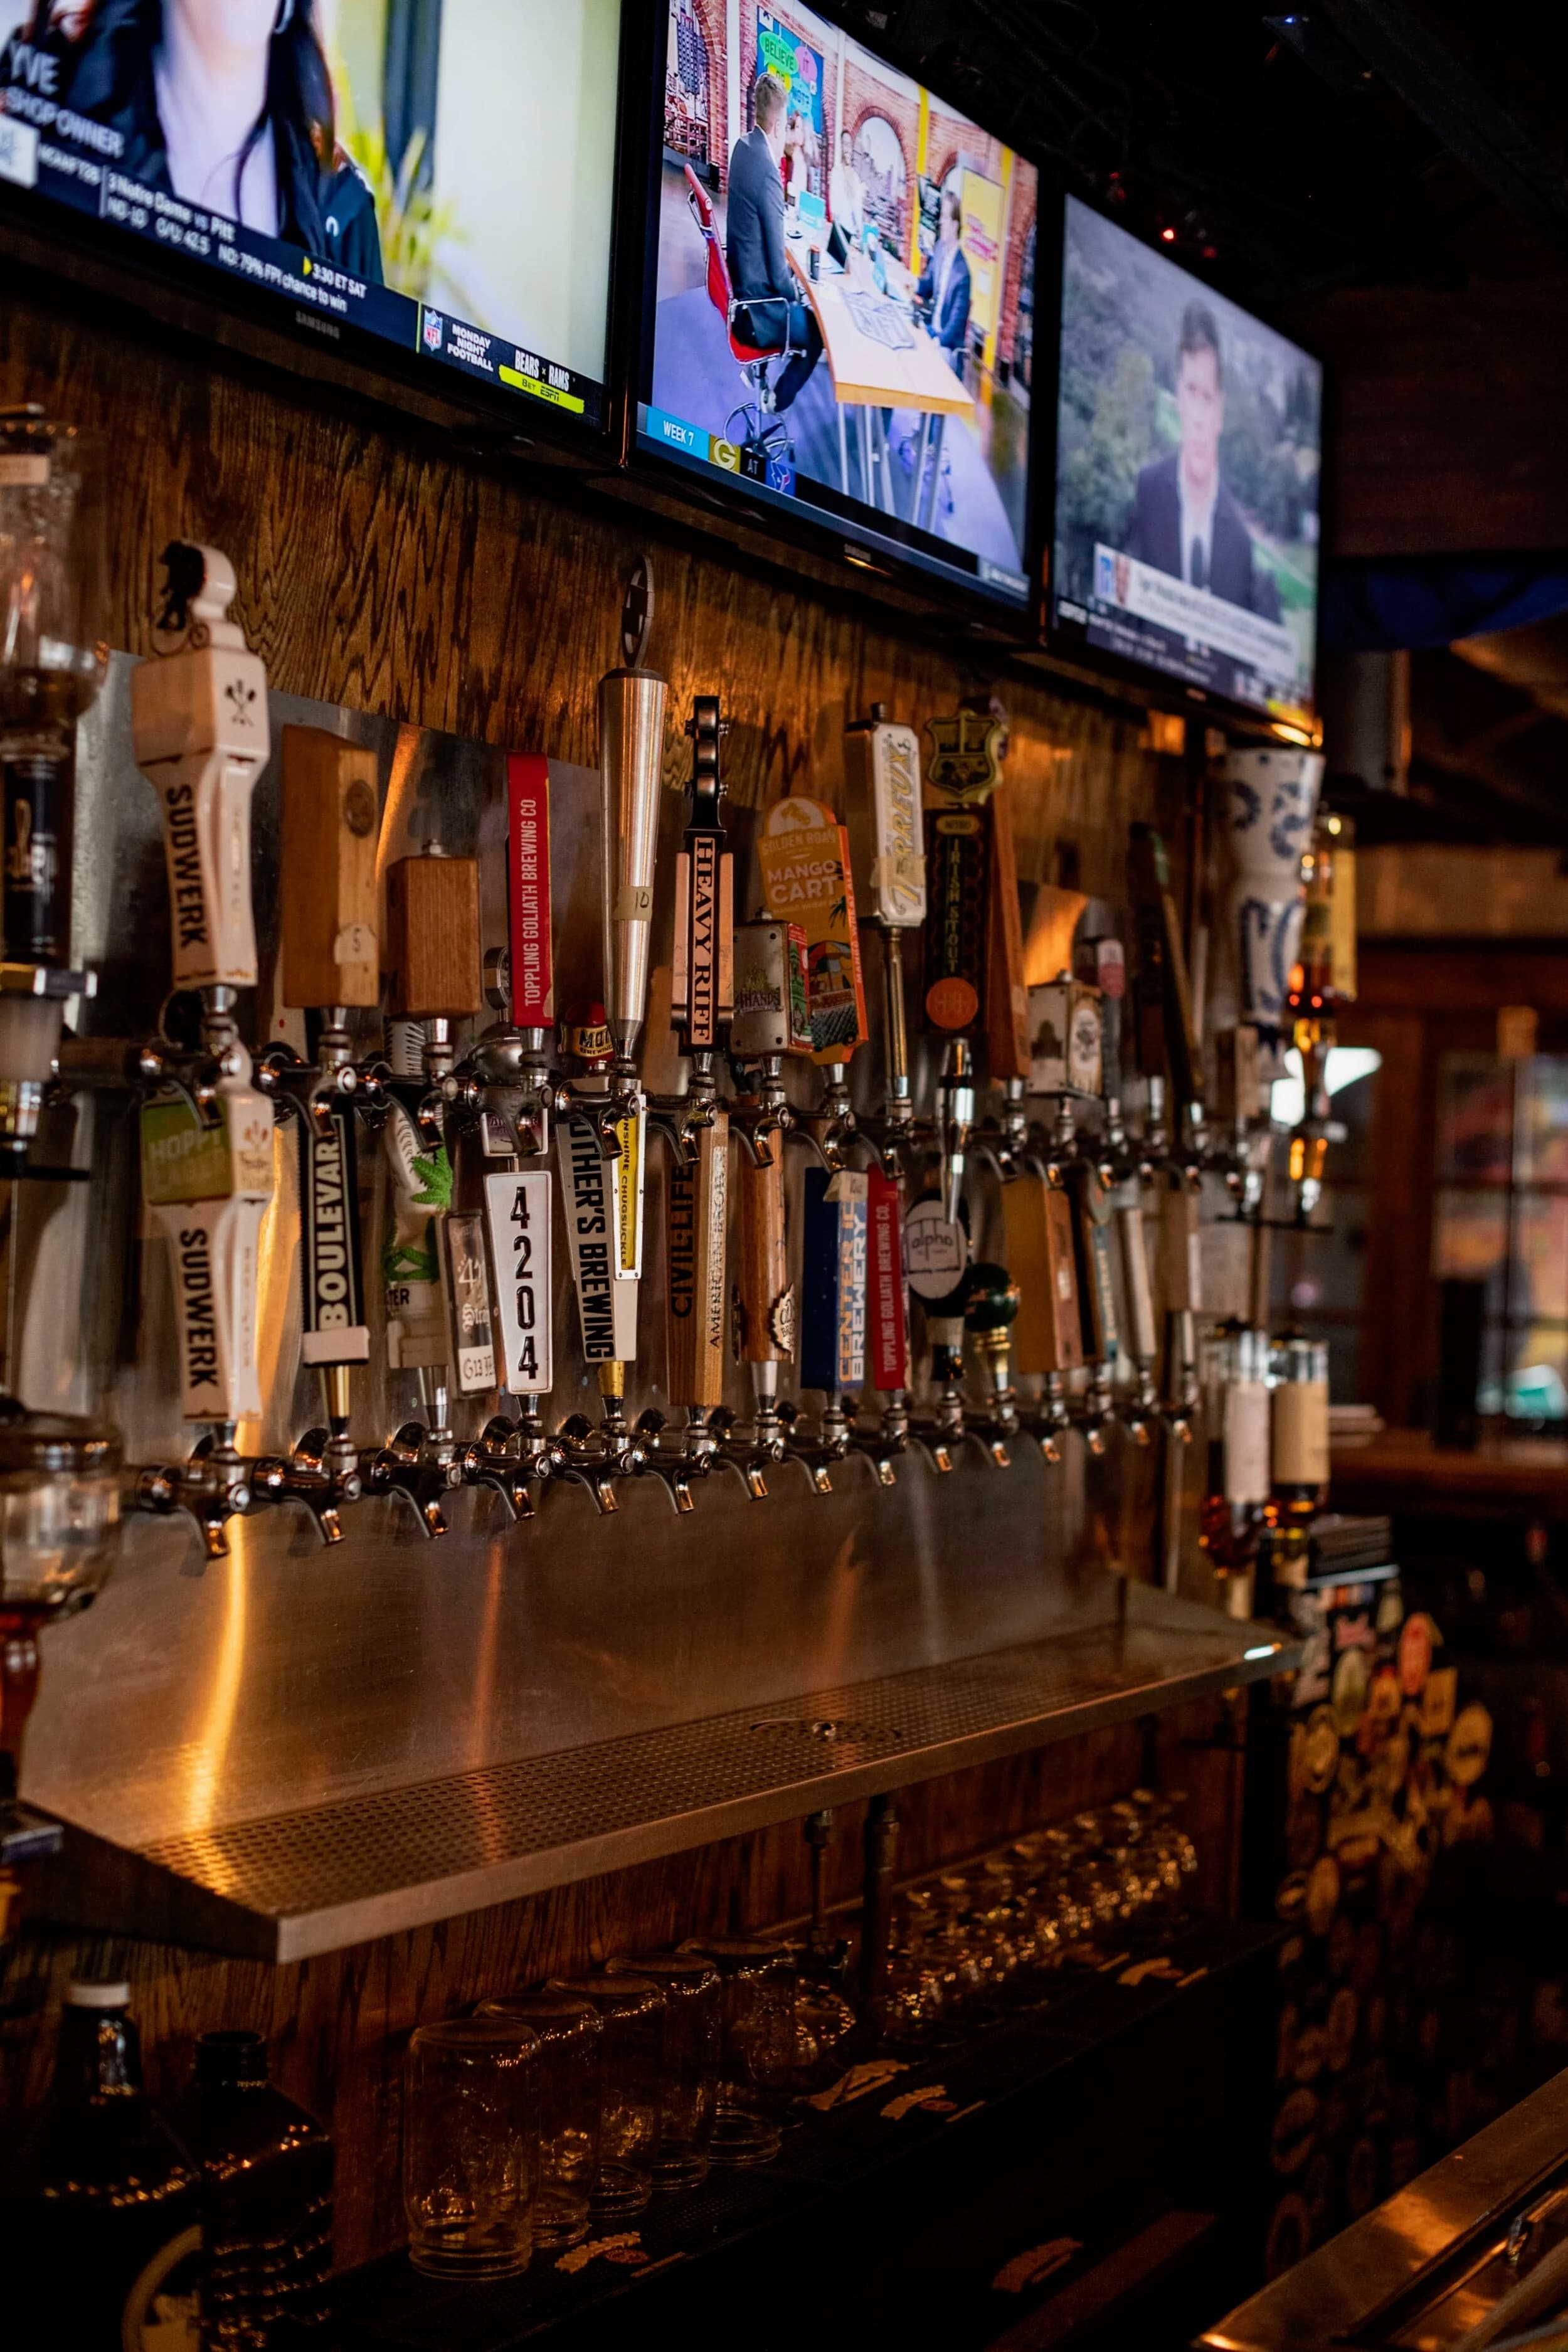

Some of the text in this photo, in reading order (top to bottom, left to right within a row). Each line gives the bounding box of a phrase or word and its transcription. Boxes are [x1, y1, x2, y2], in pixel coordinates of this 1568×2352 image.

[765, 37, 794, 71] BELIEVE
[802, 58, 810, 73] IT
[6, 86, 59, 126] SHOP
[55, 109, 124, 159] OWNER
[108, 172, 236, 243] 3 Notre Dame vs Pitt
[282, 273, 318, 302] chance
[317, 287, 329, 306] to
[329, 294, 349, 313] win
[312, 263, 368, 299] 3:30 ET SAT
[295, 310, 341, 339] SAMSUNG
[426, 327, 440, 345] NFL
[452, 323, 491, 349] MONDAY
[457, 337, 486, 357] NIGHT
[447, 343, 494, 373] FOOTBALL
[514, 349, 539, 379] BEARS
[548, 364, 569, 392] RAMS
[540, 386, 559, 402] ESPN
[663, 420, 694, 447] WEEK 7
[714, 438, 758, 475] G AT
[166, 784, 207, 948] SUDWERK
[521, 820, 538, 880] BREWING
[767, 859, 837, 884] MANGO
[522, 885, 539, 939] GOLIATH
[770, 876, 838, 903] CART
[948, 839, 961, 973] IRISH STOUT
[847, 894, 858, 936] WHEAT
[692, 838, 715, 1043] HEAVY RIFF
[852, 940, 863, 983] MANGO
[524, 943, 541, 1006] TOPPLING
[622, 1117, 630, 1172] NSHINE
[315, 1136, 349, 1330] BOULEVAR
[569, 1120, 615, 1360] OTHER'S BREWING
[878, 1227, 893, 1273] BREWING
[509, 1185, 539, 1380] 4204
[710, 1238, 723, 1347] AMERICAN
[839, 1200, 855, 1382] CENTER IC
[851, 1213, 867, 1381] BREWERY
[881, 1274, 896, 1320] GOLIATH
[180, 1227, 218, 1388] SUDWERK
[882, 1322, 897, 1373] TOPPLING
